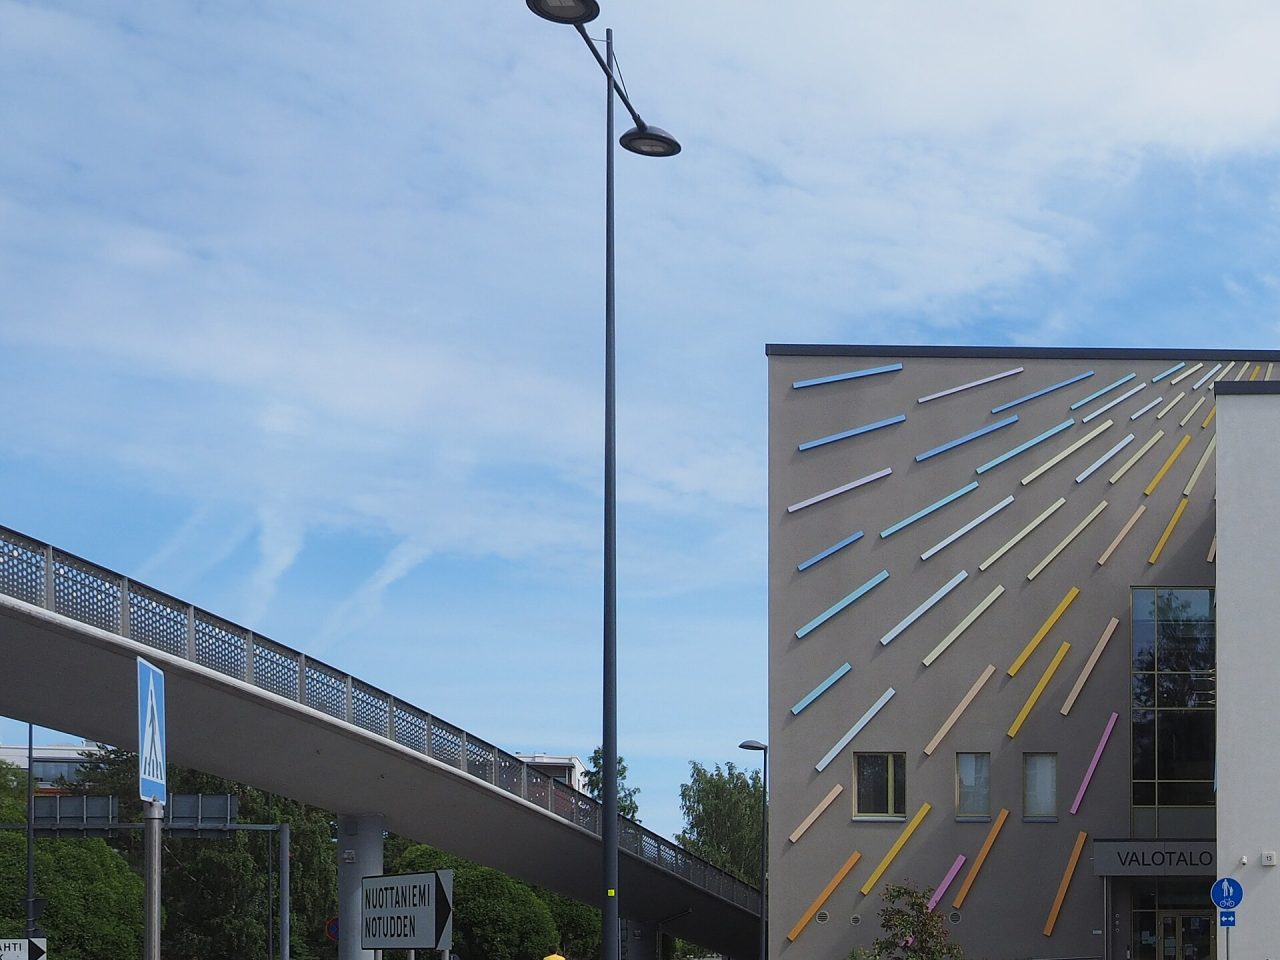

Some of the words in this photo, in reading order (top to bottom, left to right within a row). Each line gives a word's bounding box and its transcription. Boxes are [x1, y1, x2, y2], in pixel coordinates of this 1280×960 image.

[1117, 850, 1213, 866] VALOTALO
[365, 884, 430, 909] NUOTTANIEMI
[365, 915, 416, 938] NOTUDDEN
